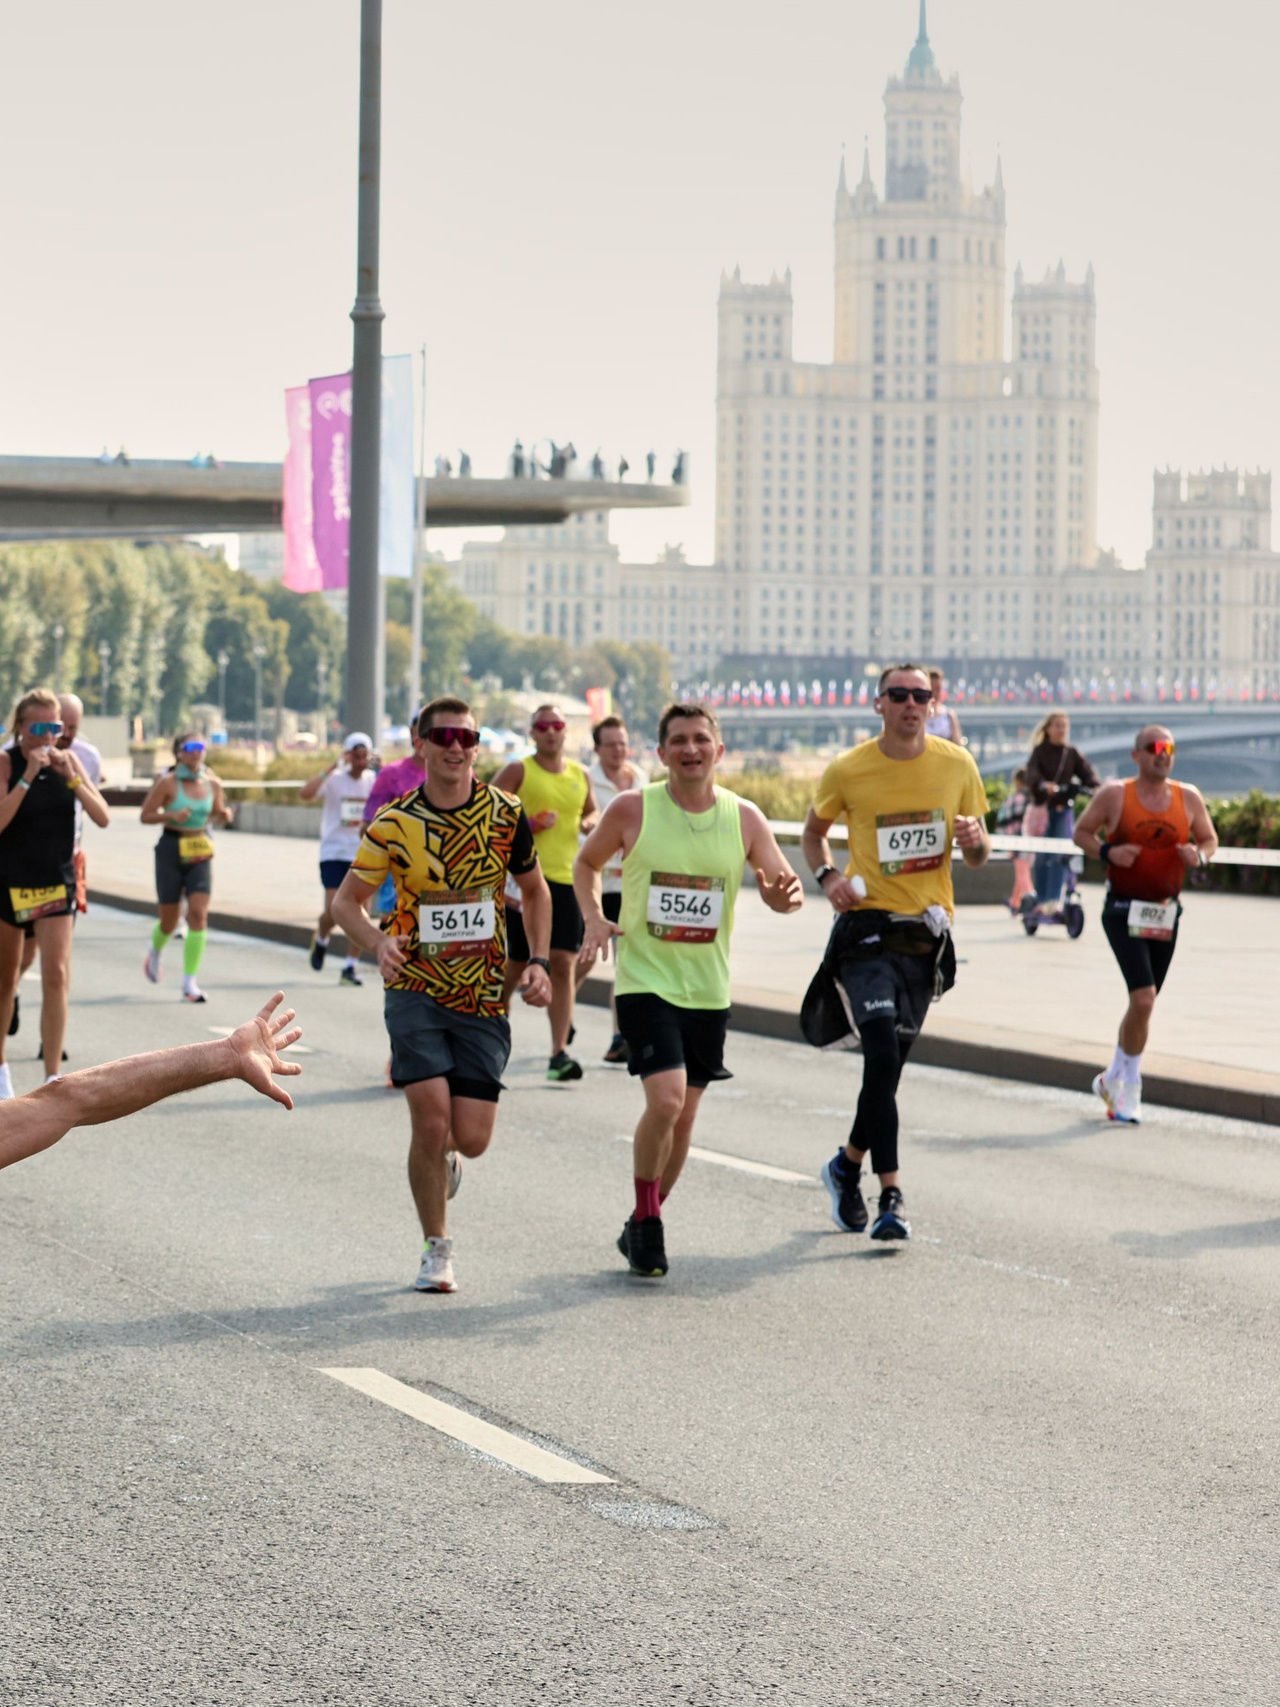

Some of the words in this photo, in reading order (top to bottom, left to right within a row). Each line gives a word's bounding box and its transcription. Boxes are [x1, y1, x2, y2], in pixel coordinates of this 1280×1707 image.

[889, 828, 937, 849] 6975
[660, 893, 711, 916] 5546
[431, 908, 485, 931] 5614
[441, 931, 476, 939] ДМИТРИЙ
[428, 944, 438, 955] D
